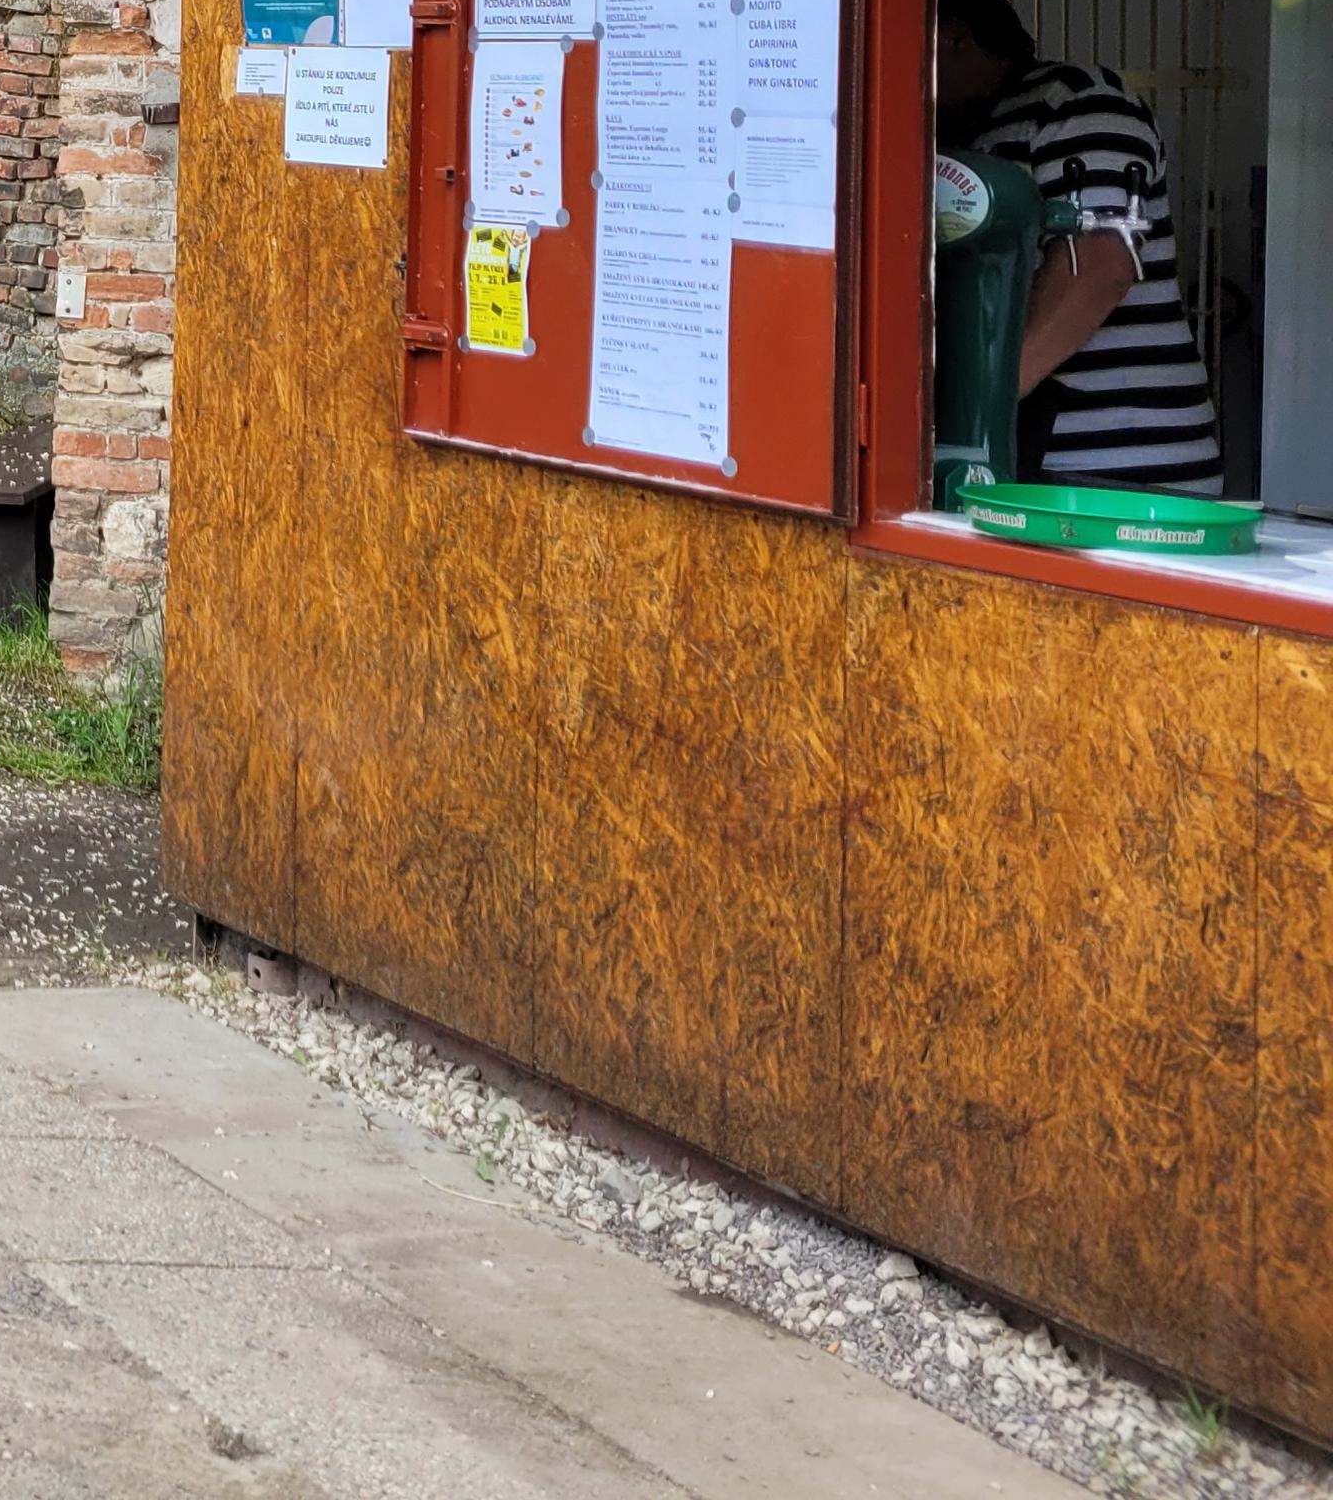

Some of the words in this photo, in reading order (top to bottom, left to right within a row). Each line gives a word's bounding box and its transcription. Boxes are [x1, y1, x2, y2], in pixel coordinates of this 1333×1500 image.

[749, 0, 782, 11] MOJITO
[484, 15, 518, 26] ALKOHOL
[749, 19, 772, 30] CUBA
[774, 19, 797, 30] LIBRE
[749, 39, 798, 49] CAIPIRINHA
[749, 58, 798, 69] GIN&TONIC
[301, 68, 325, 79] STÁNKU
[326, 70, 334, 79] SE
[335, 70, 376, 81] KONZUMUJE
[748, 77, 768, 88] PINK
[770, 78, 818, 89] GIN&TONIC
[323, 85, 344, 95] POUZE
[295, 100, 311, 110] JÍDLO
[312, 102, 316, 110] A
[332, 102, 352, 113] KTERÉ
[353, 104, 368, 114] JSTE
[369, 104, 375, 114] U
[325, 116, 339, 128] NÁS
[329, 133, 364, 146] DĚKUJEME
